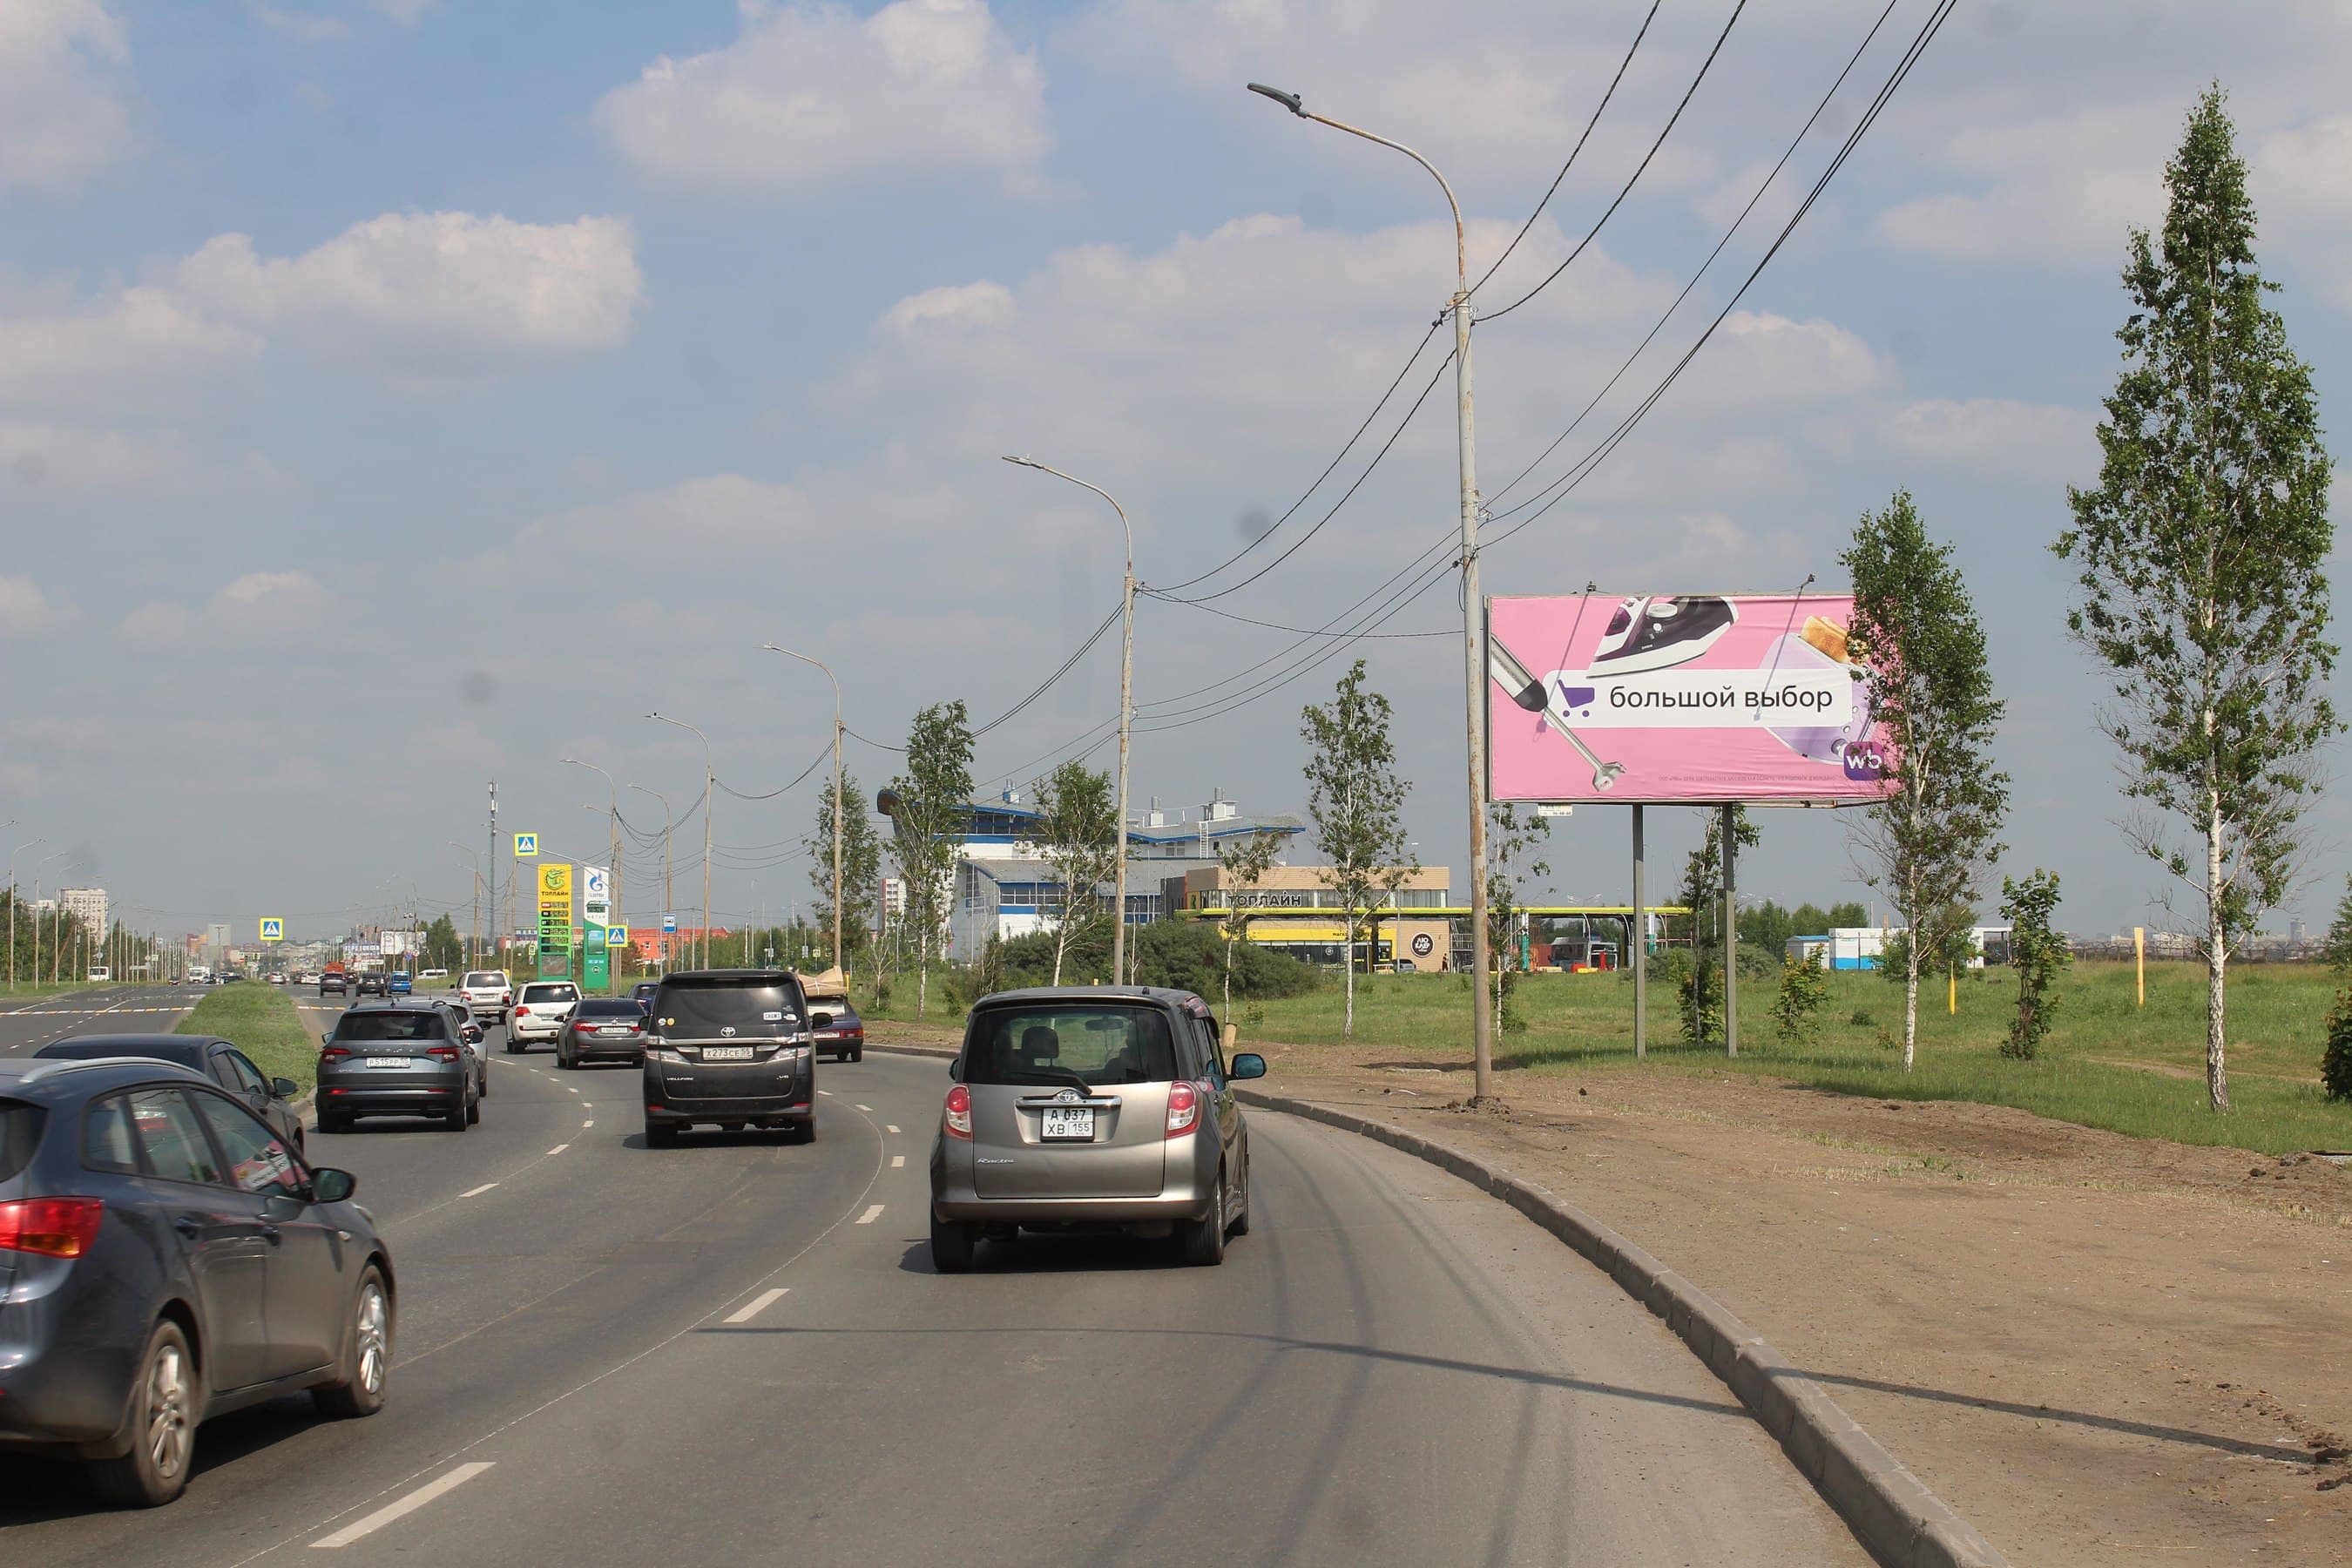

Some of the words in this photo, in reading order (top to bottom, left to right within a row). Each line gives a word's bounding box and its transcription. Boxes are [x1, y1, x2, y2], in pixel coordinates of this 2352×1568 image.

[1610, 686, 1735, 707] большой
[1745, 685, 1833, 713] выбор
[1227, 889, 1302, 907] ТОПЛАЙН
[1051, 1109, 1058, 1120] А
[1064, 1109, 1086, 1121] 037
[1047, 1124, 1065, 1134] ХВ
[1072, 1123, 1090, 1132] 155
